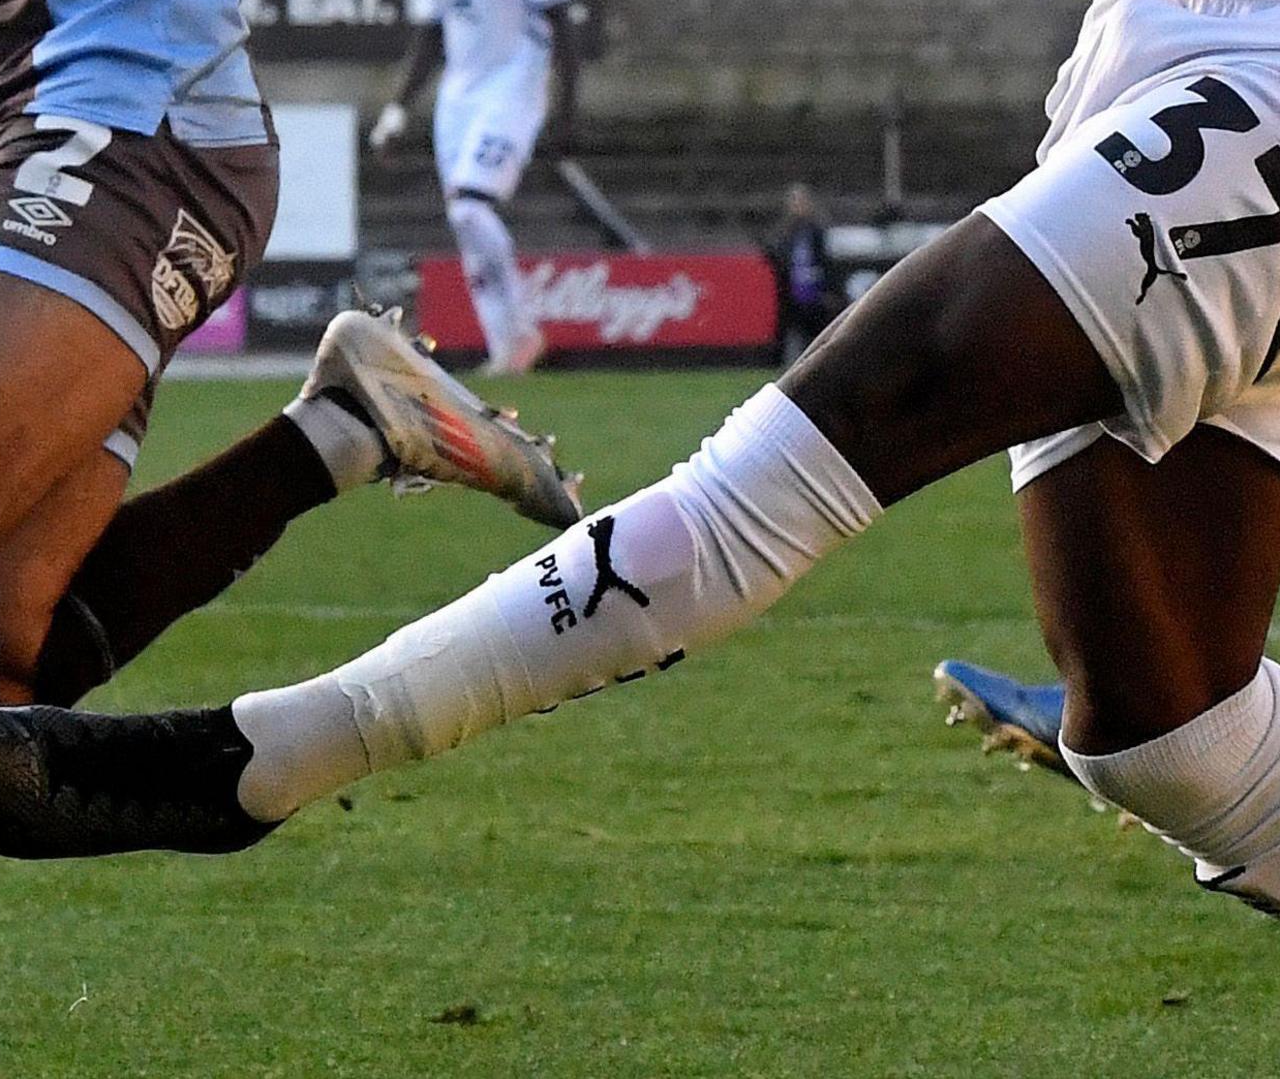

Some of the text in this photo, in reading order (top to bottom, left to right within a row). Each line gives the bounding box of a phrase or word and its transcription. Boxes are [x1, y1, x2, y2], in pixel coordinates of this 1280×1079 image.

[13, 113, 112, 207] 2
[2, 219, 56, 246] umbro
[534, 553, 578, 636] PVFC
